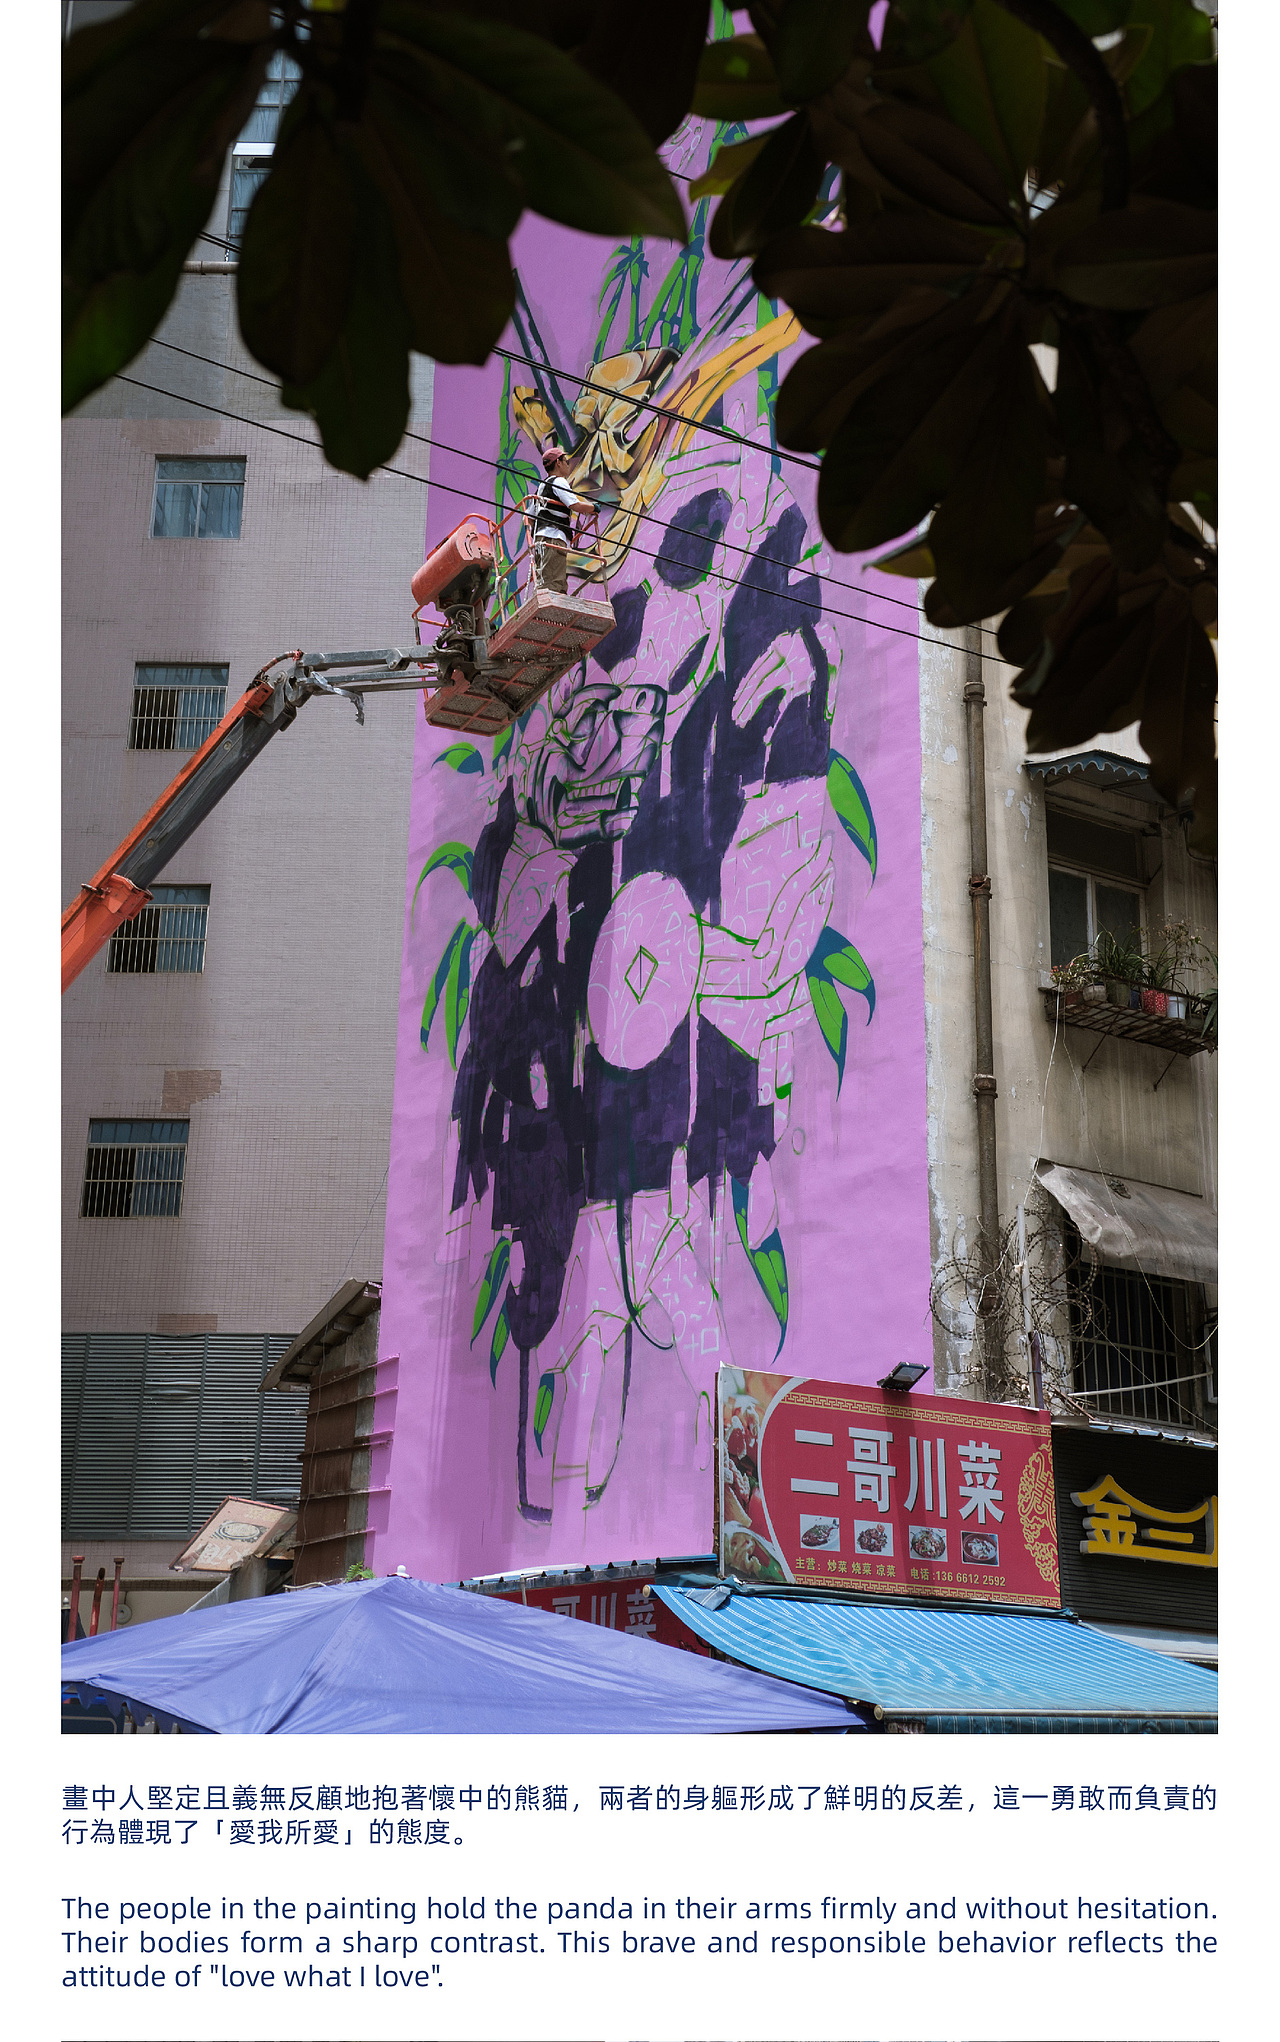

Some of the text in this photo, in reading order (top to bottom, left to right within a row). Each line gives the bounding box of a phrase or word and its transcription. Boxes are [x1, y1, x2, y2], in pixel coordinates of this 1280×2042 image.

[791, 1426, 1005, 1524] 二哥川菜
[1070, 1474, 1218, 1568] 金三
[827, 1559, 848, 1574] 炒菜
[851, 1561, 872, 1576] 烧菜
[876, 1564, 896, 1578] 凉菜
[910, 1567, 930, 1581] 电话
[956, 1572, 980, 1585] 6612
[982, 1574, 1006, 1587] 2592
